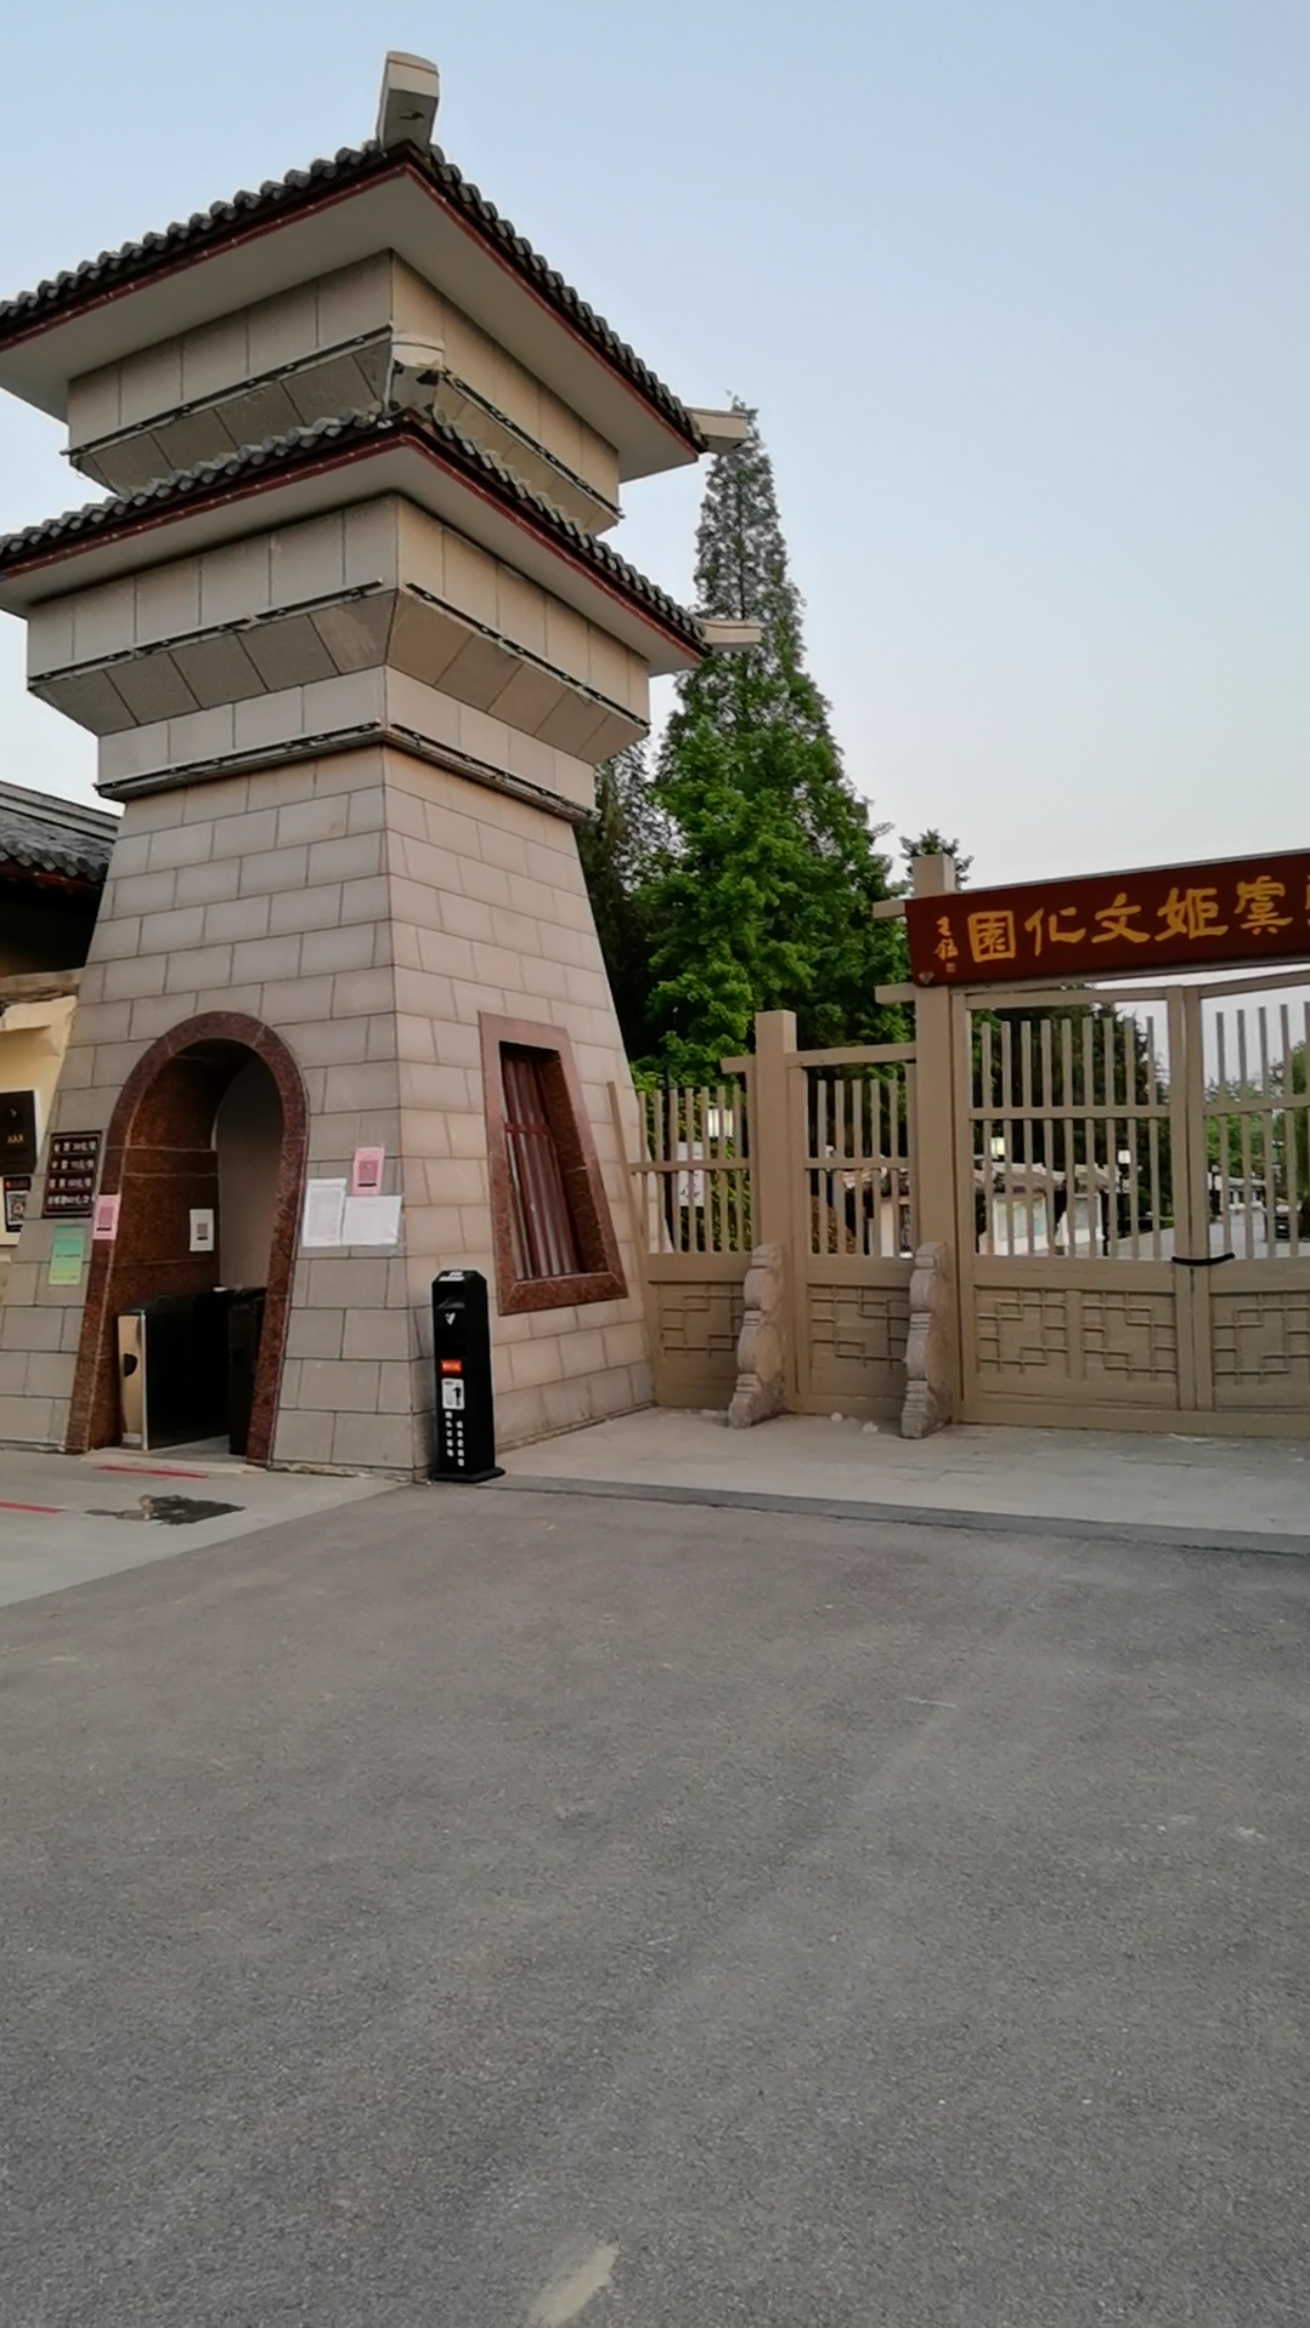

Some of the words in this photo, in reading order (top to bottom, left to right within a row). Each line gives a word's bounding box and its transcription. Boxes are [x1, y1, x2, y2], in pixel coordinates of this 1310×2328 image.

[967, 876, 1310, 962] 虞姬文化園
